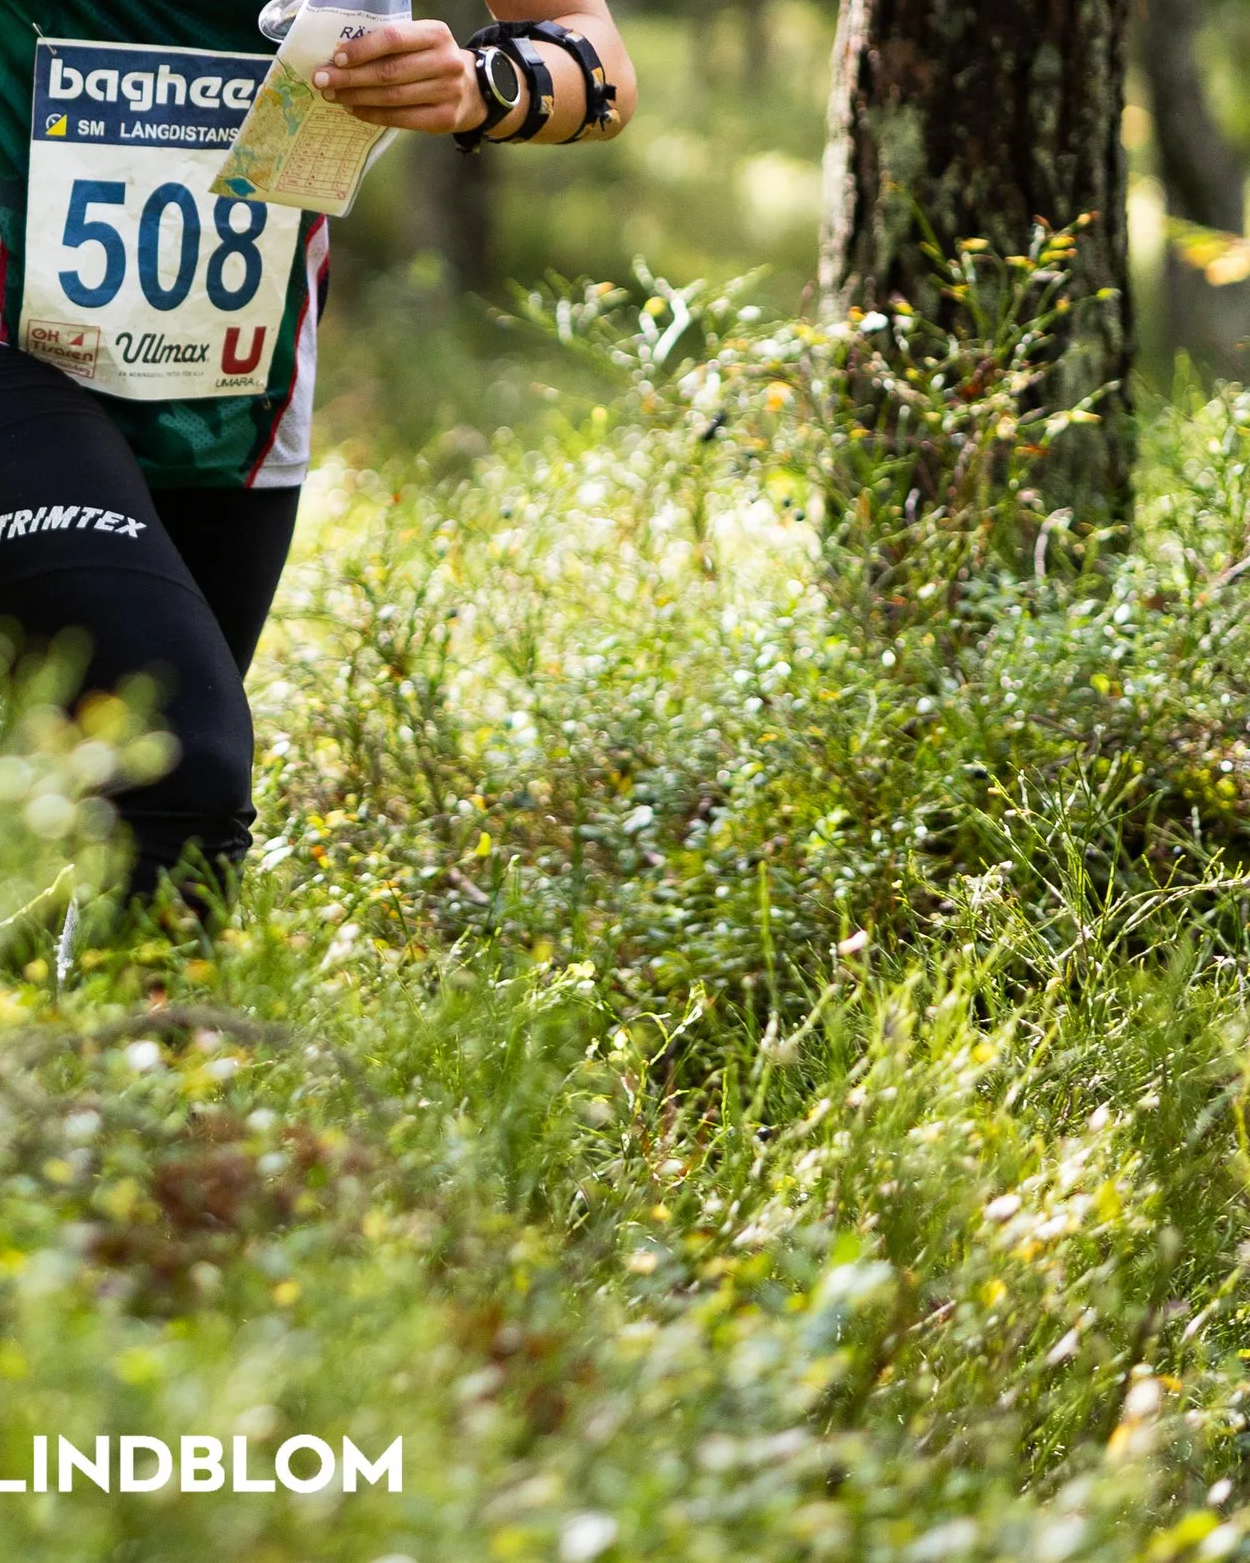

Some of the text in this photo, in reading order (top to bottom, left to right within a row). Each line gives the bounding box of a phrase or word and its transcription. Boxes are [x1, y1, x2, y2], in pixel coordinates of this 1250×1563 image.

[48, 58, 256, 112] baghee
[77, 119, 105, 136] SM
[58, 179, 268, 312] 508
[115, 332, 210, 364] Ullmax
